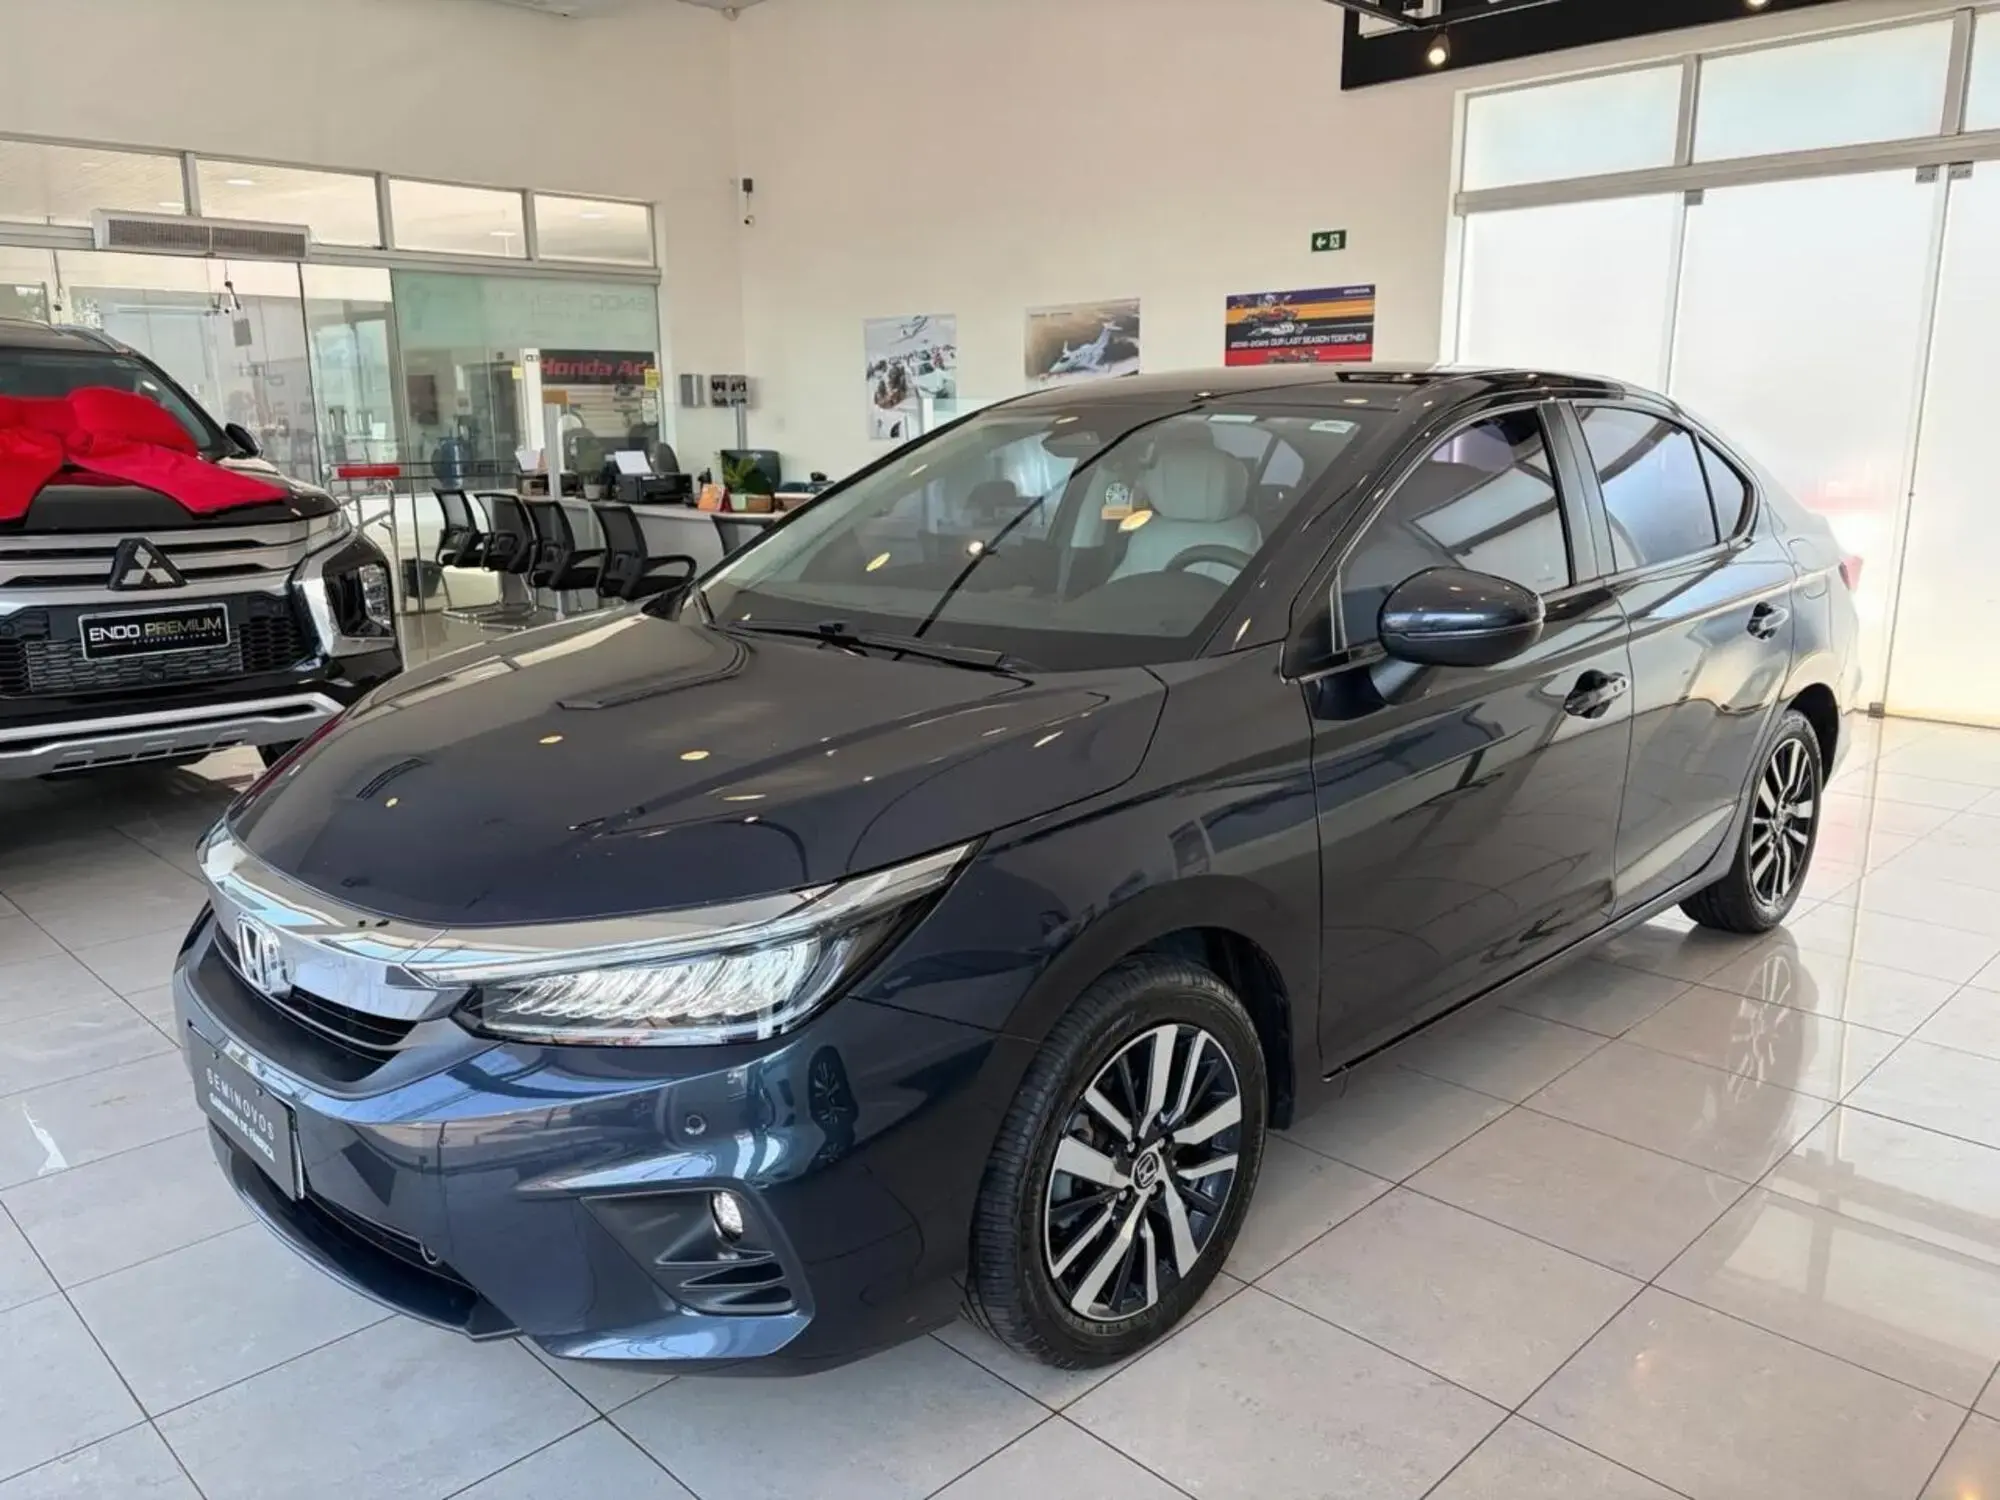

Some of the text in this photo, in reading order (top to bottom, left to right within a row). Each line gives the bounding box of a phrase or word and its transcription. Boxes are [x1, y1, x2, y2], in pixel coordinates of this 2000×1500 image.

[1302, 334, 1330, 345] SEASON
[539, 358, 613, 376] Honda
[88, 616, 222, 642] ENDO PREMIUM
[206, 1067, 275, 1141] SEMINOVOS
